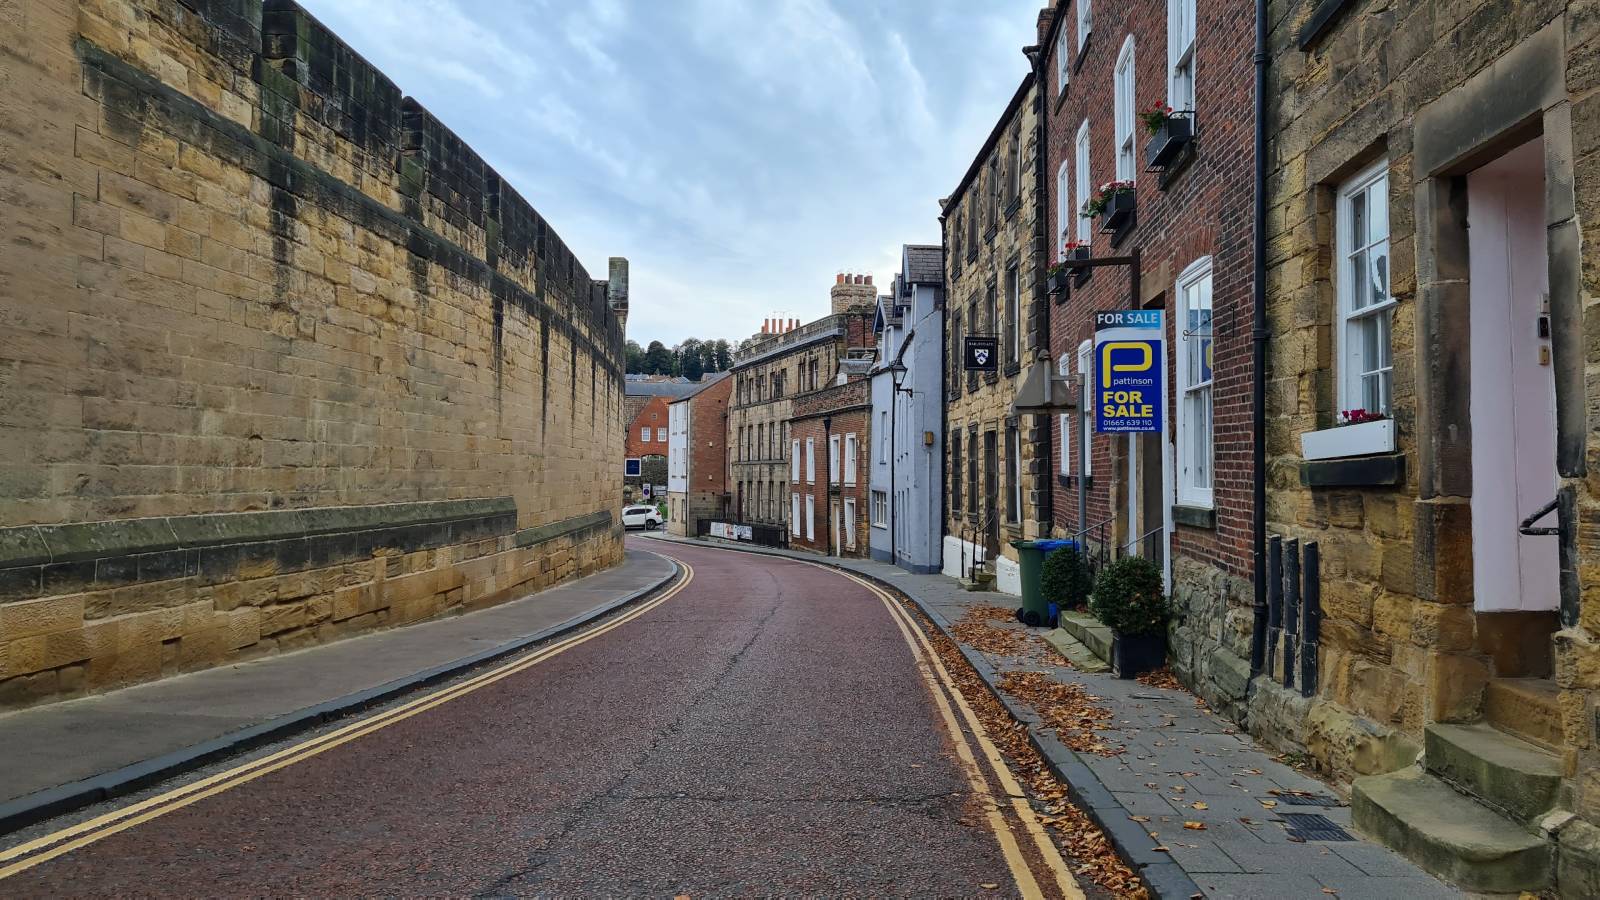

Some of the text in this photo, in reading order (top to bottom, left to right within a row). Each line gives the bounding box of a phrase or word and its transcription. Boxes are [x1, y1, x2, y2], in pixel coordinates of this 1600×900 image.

[1097, 313, 1157, 324] FOR SALE
[1103, 342, 1152, 388] P
[1113, 378, 1152, 386] pattinson
[1103, 391, 1142, 403] FOR
[1103, 405, 1153, 417] SALE
